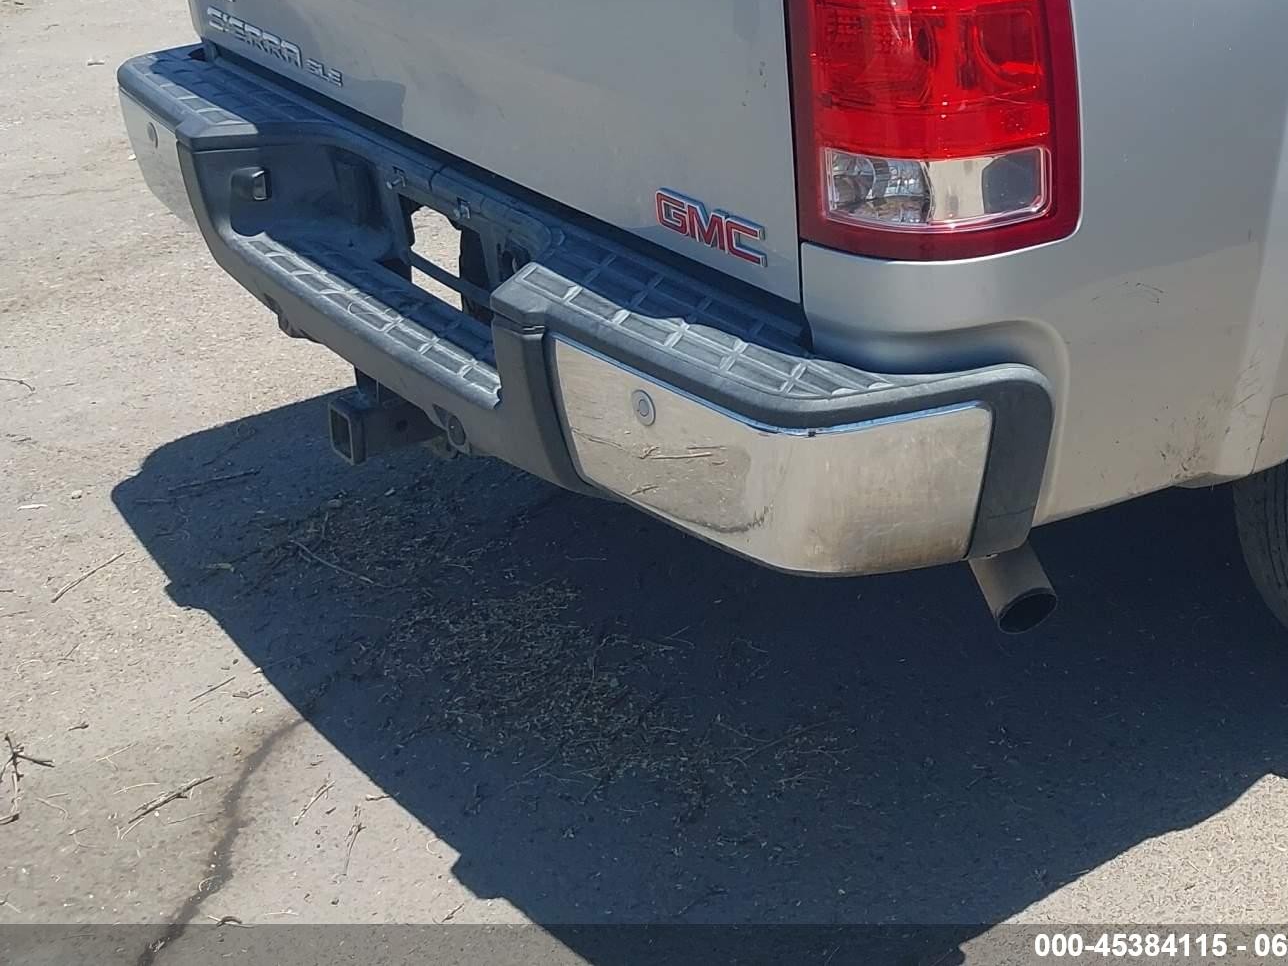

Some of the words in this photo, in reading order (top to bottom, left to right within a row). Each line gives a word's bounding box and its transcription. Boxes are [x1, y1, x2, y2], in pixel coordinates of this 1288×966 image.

[207, 5, 303, 68] SIERRA
[305, 57, 344, 87] SLE
[655, 186, 768, 267] GMC
